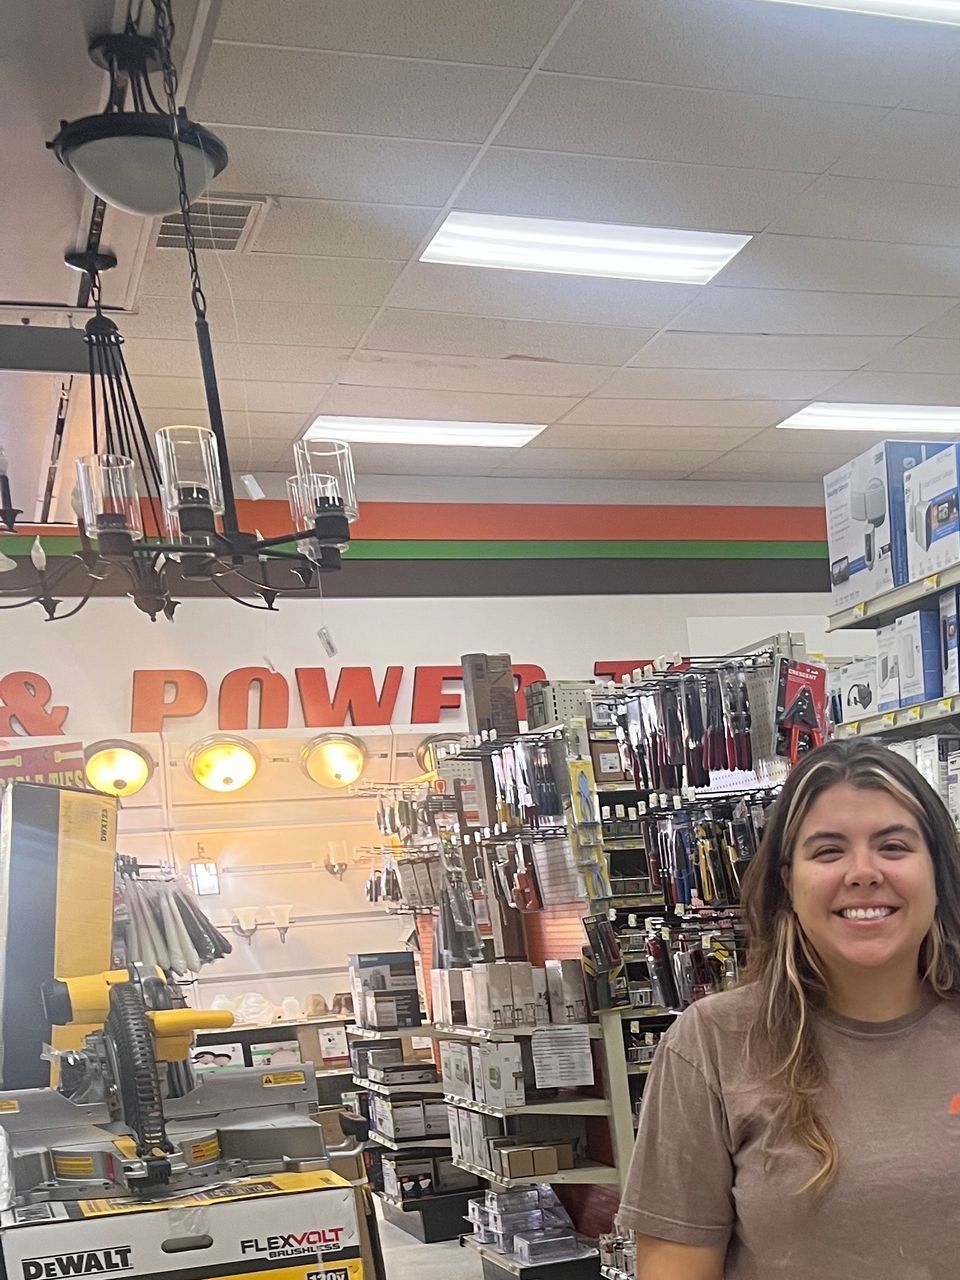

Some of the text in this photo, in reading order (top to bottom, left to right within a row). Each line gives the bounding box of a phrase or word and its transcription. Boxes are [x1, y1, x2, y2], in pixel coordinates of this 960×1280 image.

[788, 668, 818, 681] CRESCENT
[0, 671, 69, 737] &
[240, 1228, 343, 1254] FLEXVOLT
[268, 1243, 340, 1259] BRUSHLESS
